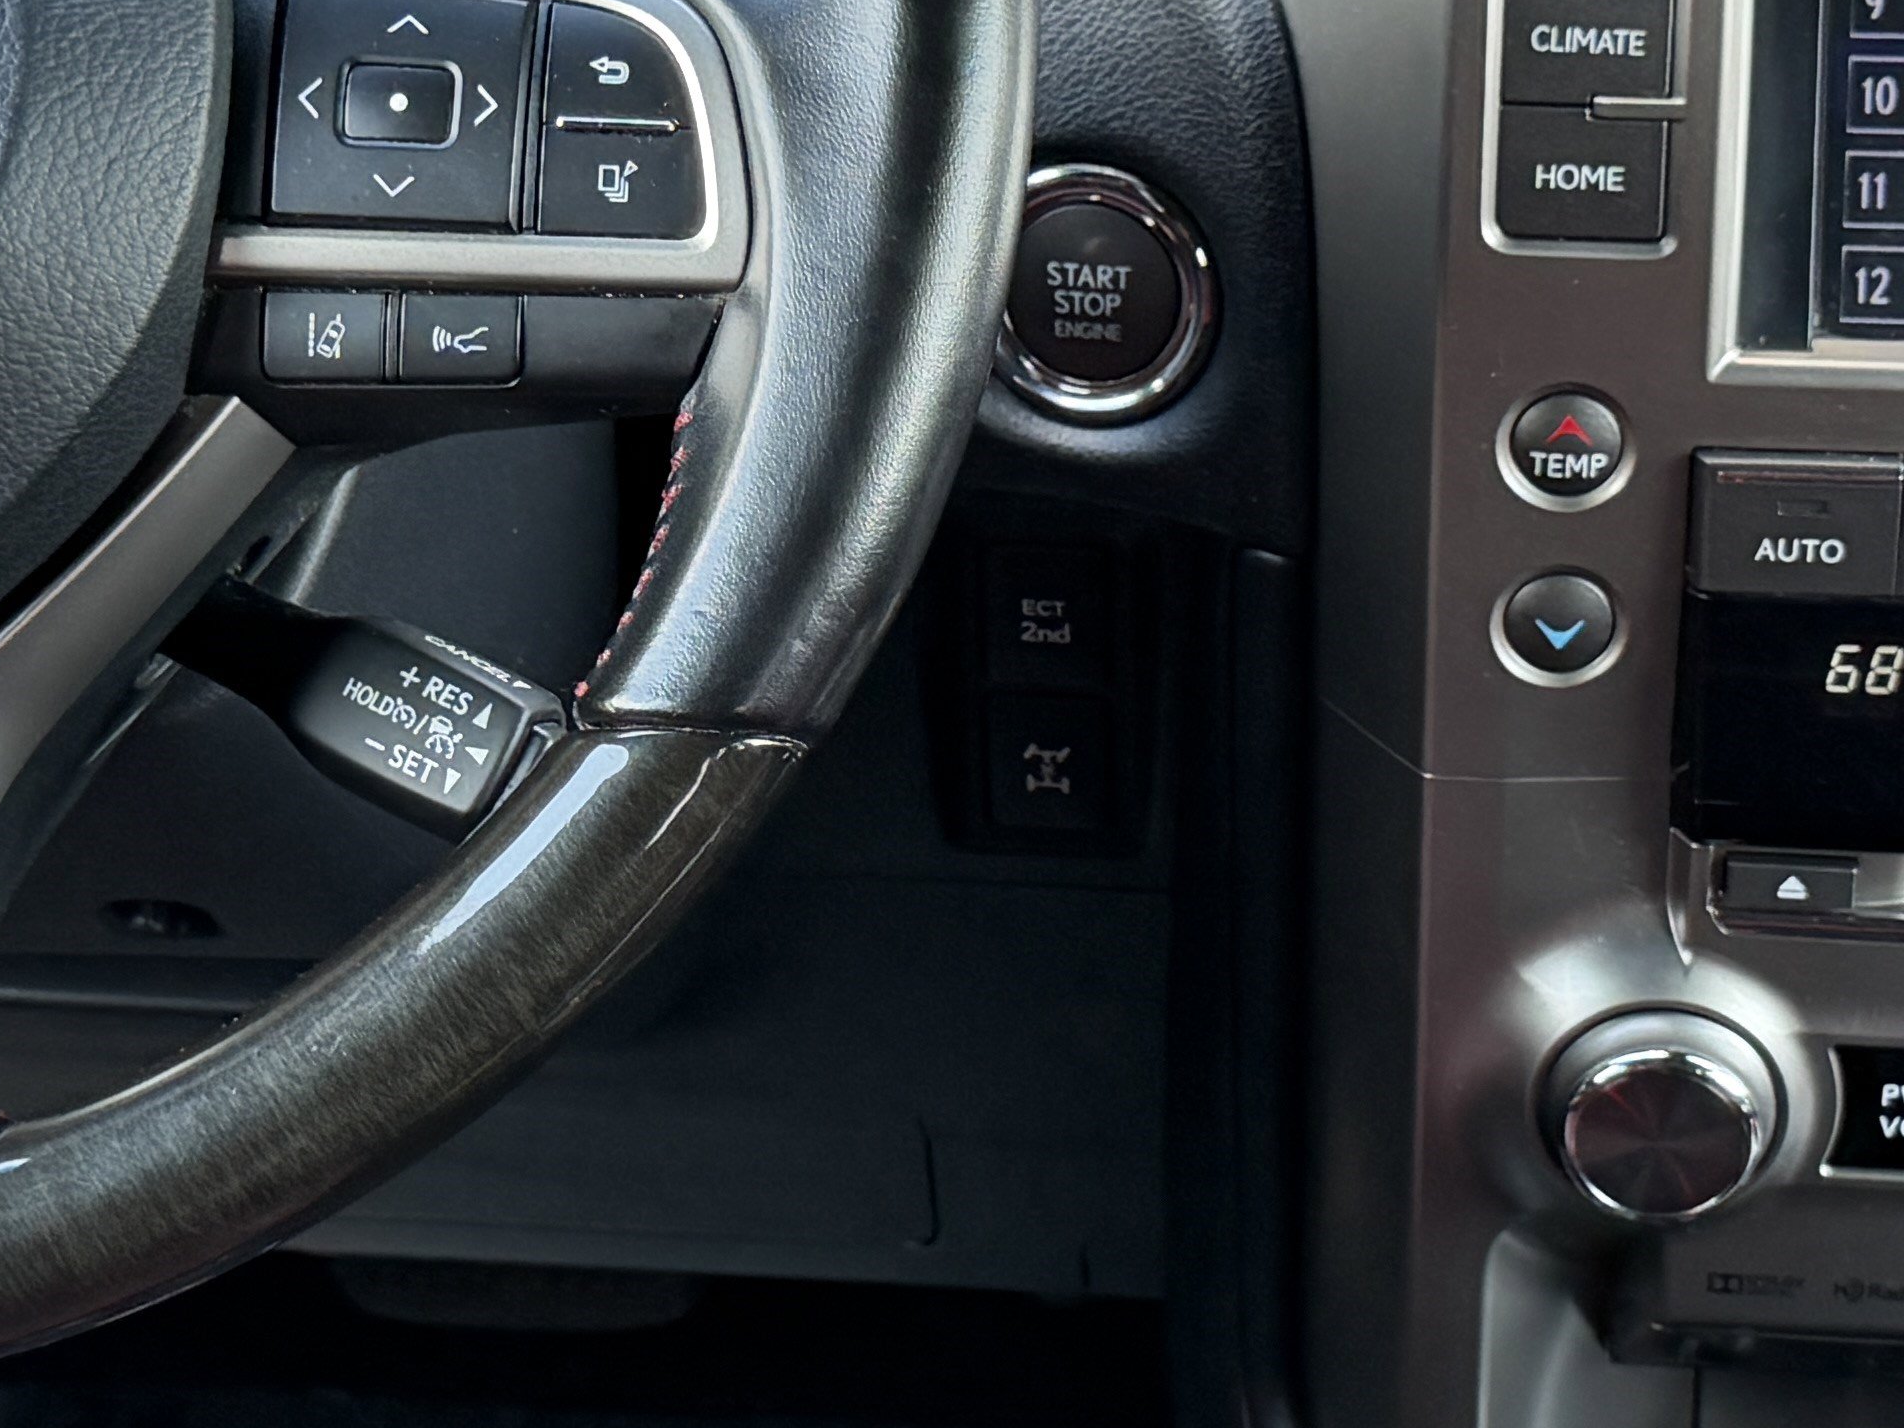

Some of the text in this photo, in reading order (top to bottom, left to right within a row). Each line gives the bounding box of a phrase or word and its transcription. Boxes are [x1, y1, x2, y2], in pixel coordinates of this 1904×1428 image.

[1530, 24, 1647, 57] CLIMATE
[1862, 76, 1899, 116] 10
[1535, 164, 1626, 192] HOME
[1858, 172, 1888, 210] 11
[1046, 261, 1132, 290] START
[1855, 267, 1892, 306] 12
[1053, 289, 1122, 317] STOP
[1054, 320, 1123, 342] ENGINE
[1529, 451, 1610, 480] TEMP
[1754, 537, 1846, 564] AUTO
[1021, 599, 1066, 618] ECT
[1019, 619, 1072, 645] 2nd
